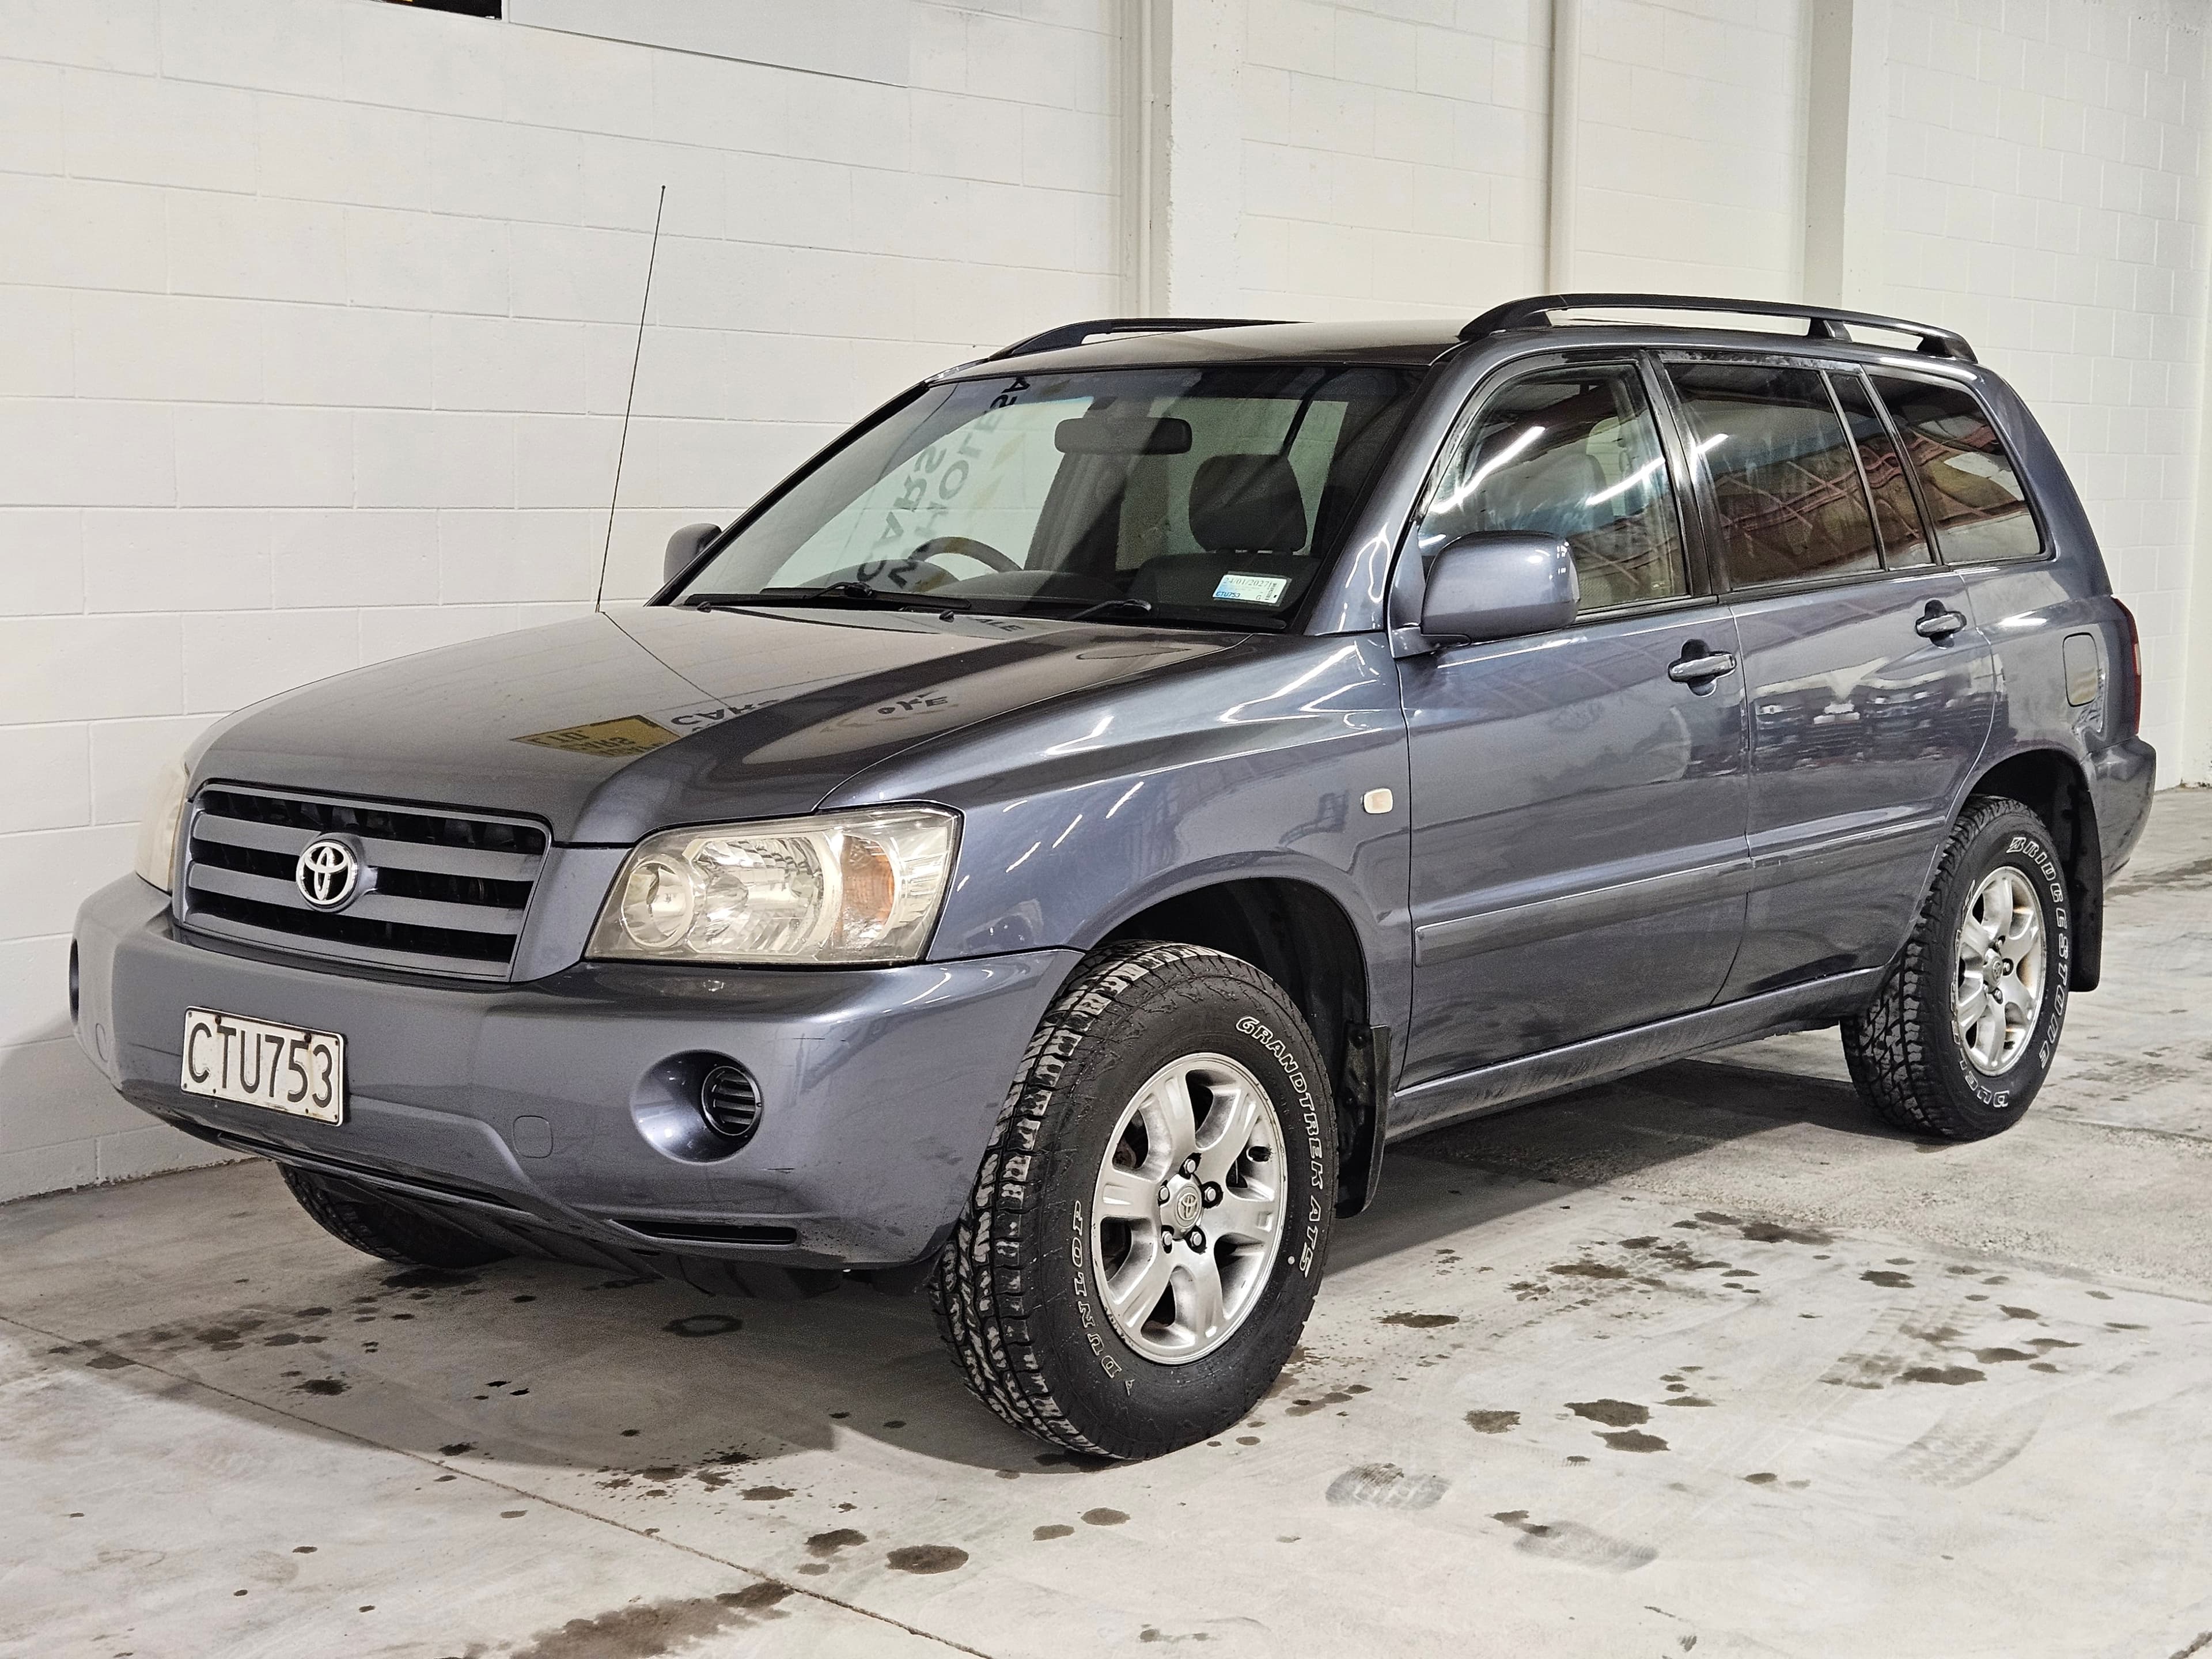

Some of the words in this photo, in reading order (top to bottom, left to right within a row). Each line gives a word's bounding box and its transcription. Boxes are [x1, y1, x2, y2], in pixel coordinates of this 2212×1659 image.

[2006, 836, 2069, 1070] BRIDGESTONE
[188, 1022, 332, 1108] CTU753
[1236, 1016, 1323, 1190] GRANDTREK
[1071, 1200, 1123, 1378] DUNLOP
